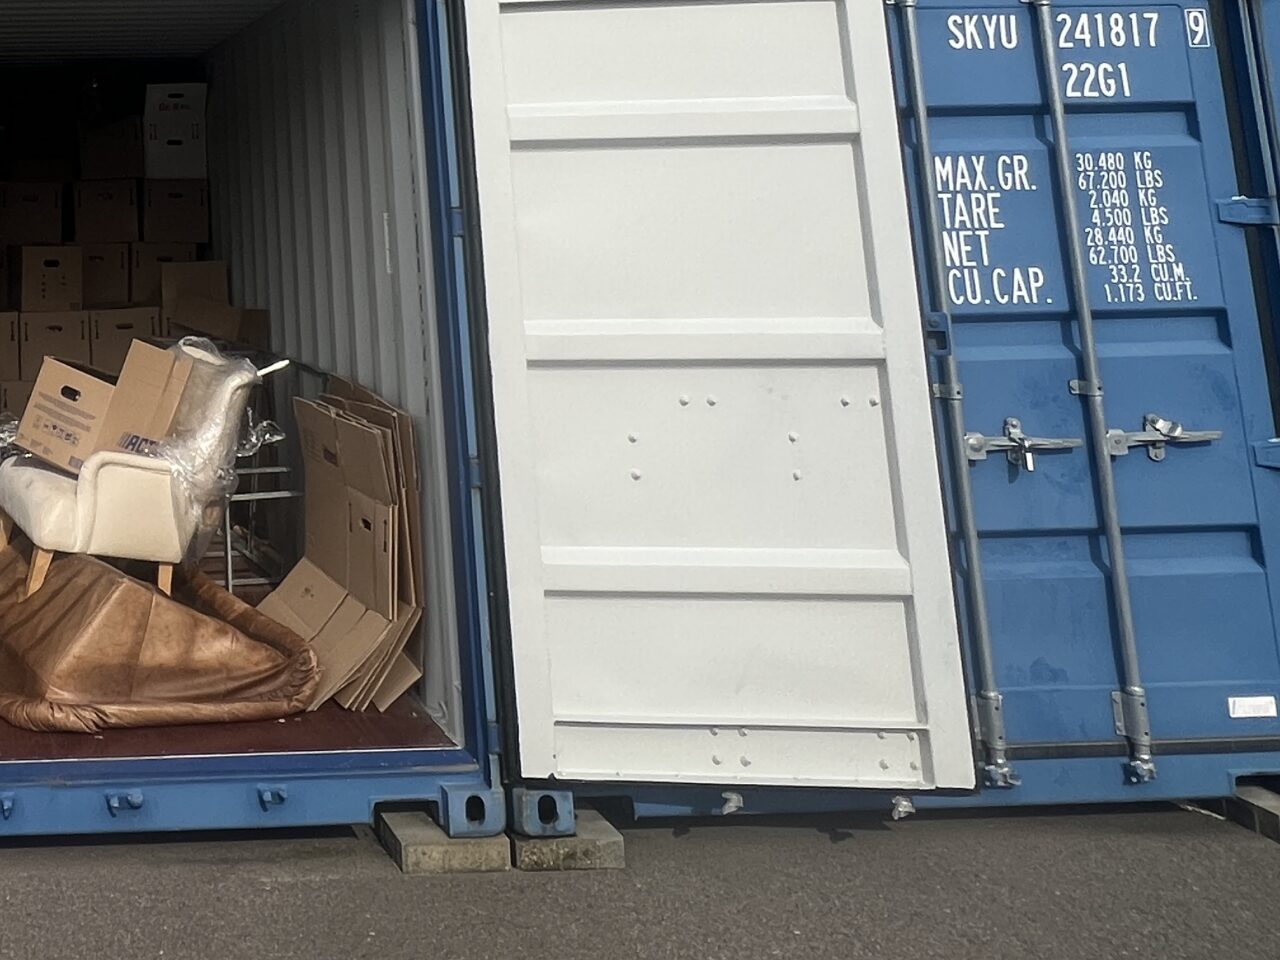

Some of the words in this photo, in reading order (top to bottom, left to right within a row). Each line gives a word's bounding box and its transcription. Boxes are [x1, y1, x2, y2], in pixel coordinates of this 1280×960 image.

[948, 15, 1017, 49] SKYU
[1057, 13, 1158, 47] 241817
[1188, 11, 1205, 45] 9
[1061, 62, 1132, 98] 22G1
[1076, 153, 1123, 172] 30.480
[1134, 152, 1151, 171] KG
[1079, 170, 1126, 191] 67.200
[1136, 170, 1162, 187] LBS
[938, 190, 1004, 228] TARE
[1089, 190, 1128, 209] 2.040
[1139, 189, 1156, 206] KG
[1092, 207, 1131, 226] 4.500
[1141, 205, 1168, 225] LBS
[1085, 227, 1134, 247] 28.440
[1144, 226, 1162, 244] KG
[943, 231, 989, 266] NET
[1090, 246, 1138, 266] 62.700
[1147, 244, 1176, 265] LBS
[1109, 265, 1141, 282] 33.2
[1151, 263, 1191, 283] CU.M.
[1105, 284, 1144, 302] 1.173
[1155, 282, 1197, 300] CU.FT.
